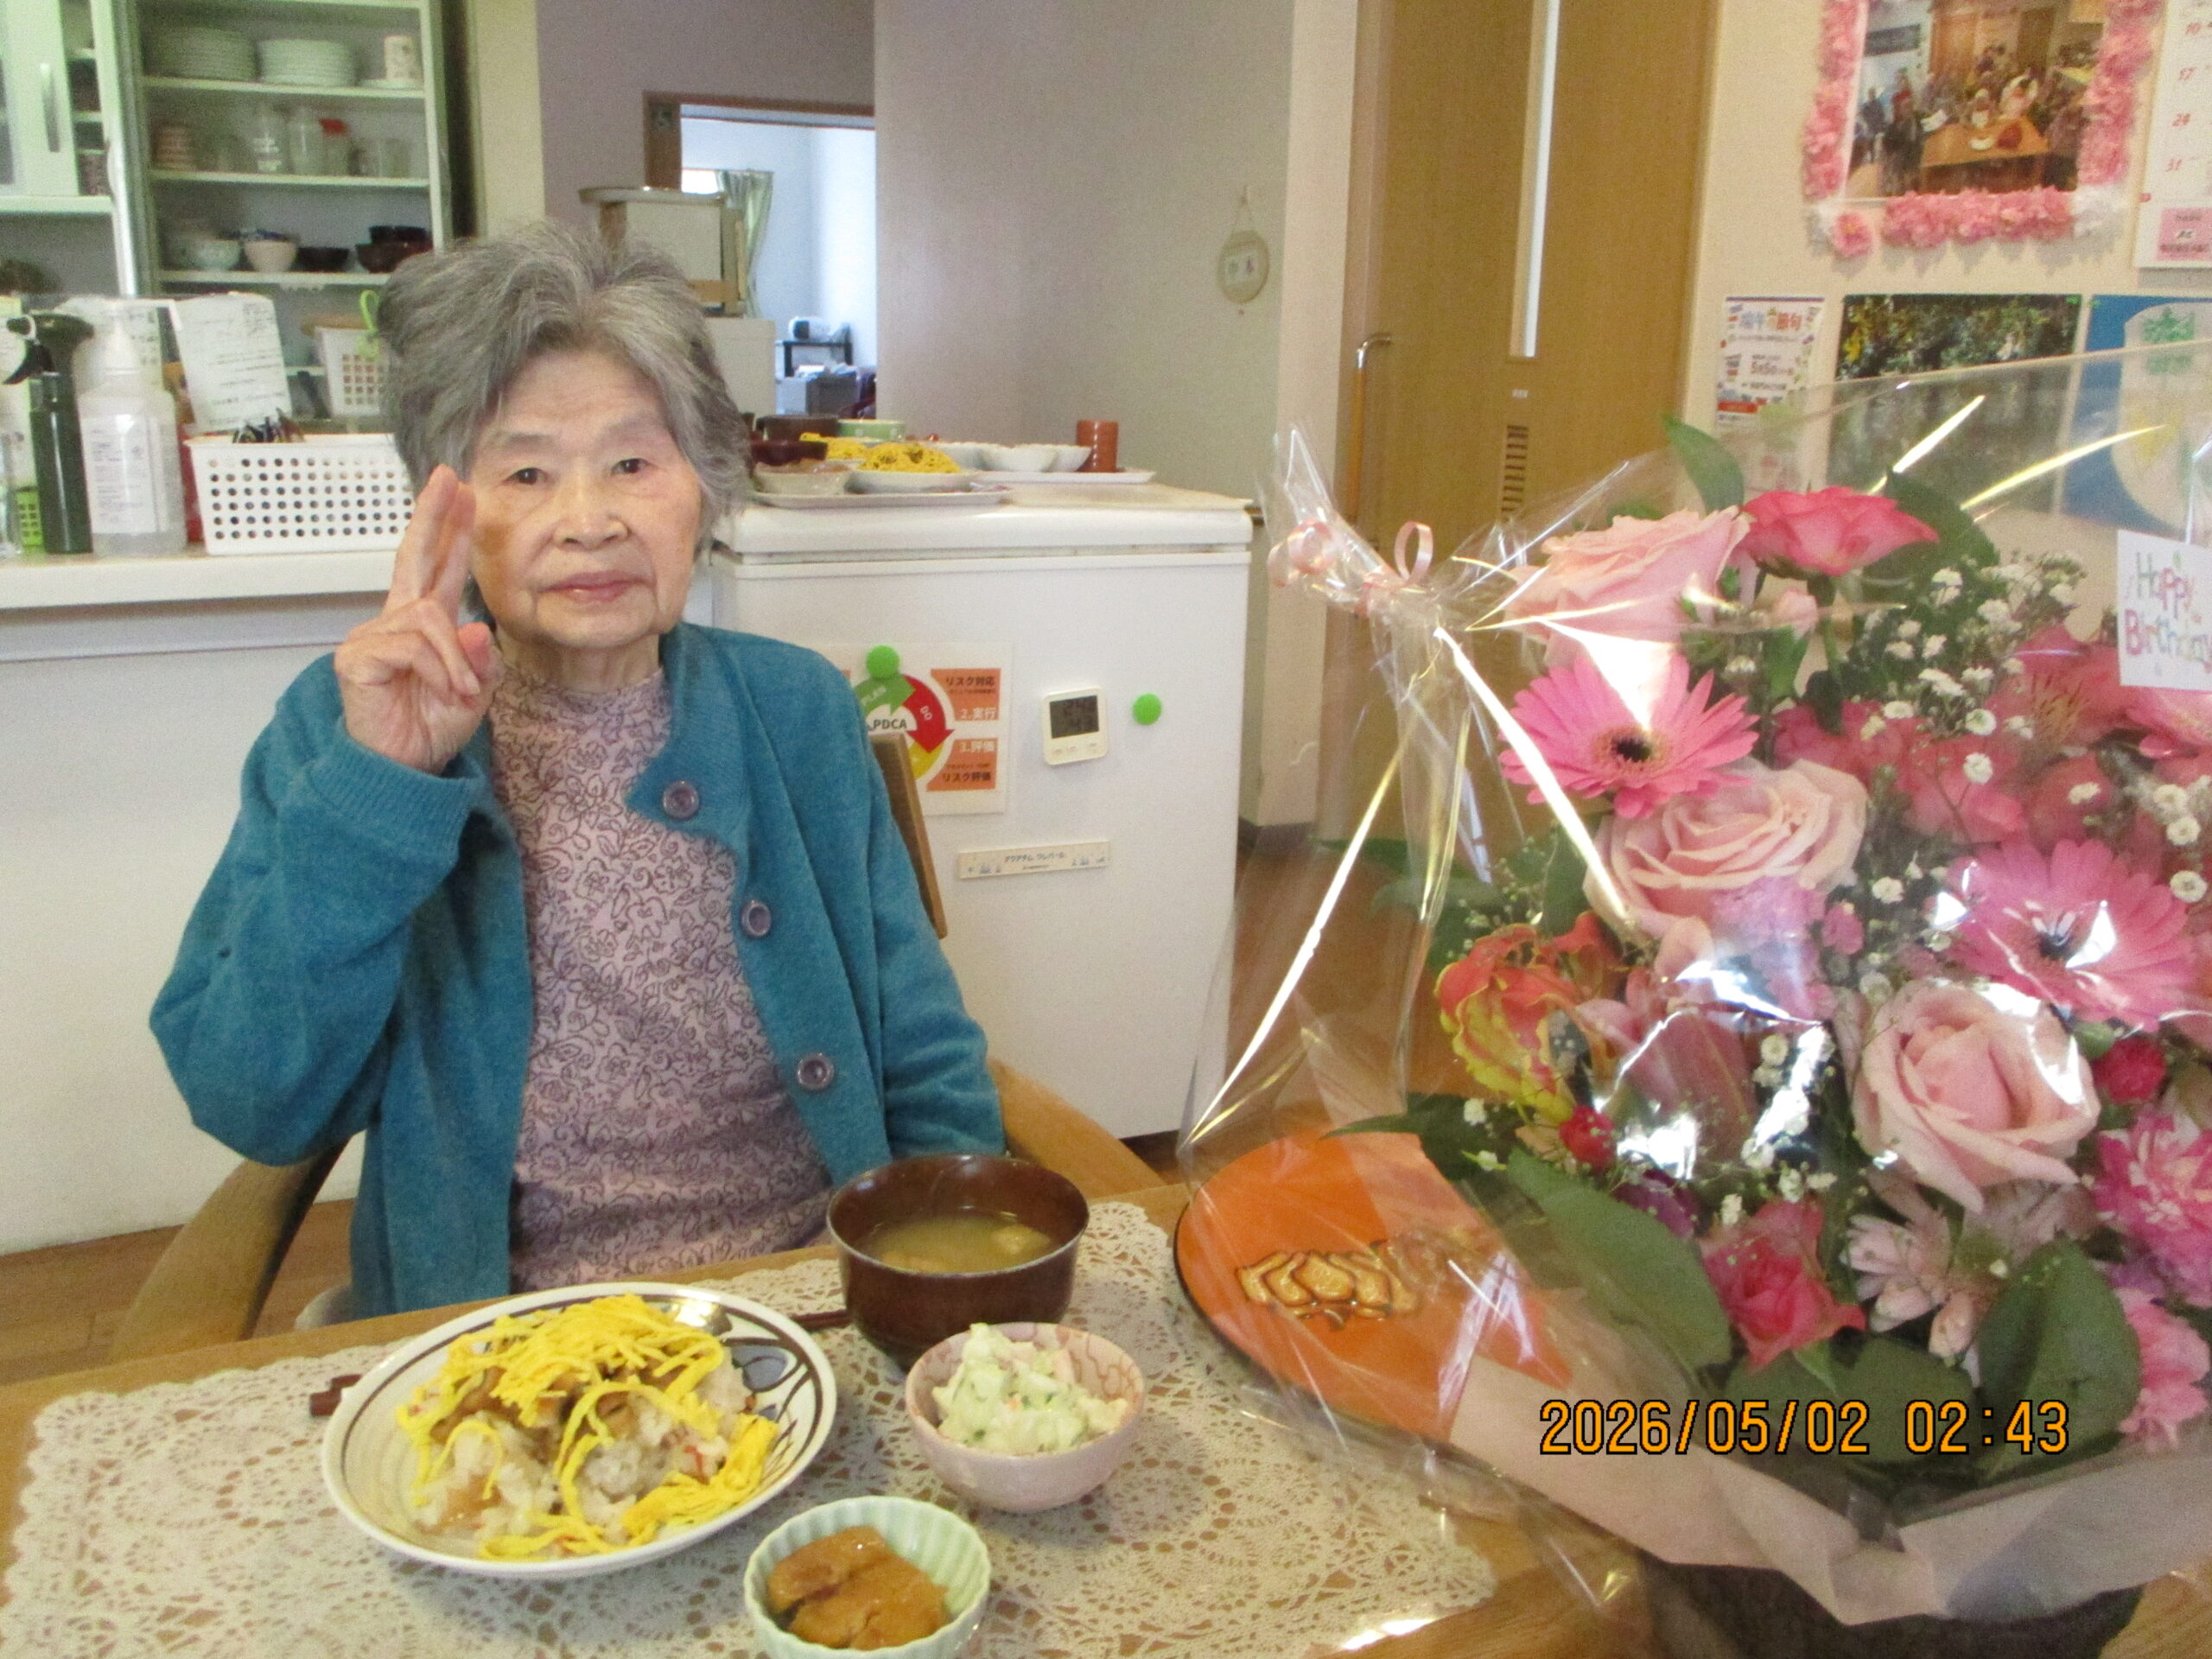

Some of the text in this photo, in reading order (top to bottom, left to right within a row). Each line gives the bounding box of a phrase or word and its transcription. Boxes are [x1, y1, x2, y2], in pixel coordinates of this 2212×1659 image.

[945, 676, 996, 686] リスク対応
[919, 705, 933, 721] DO
[873, 718, 907, 730] PDCA
